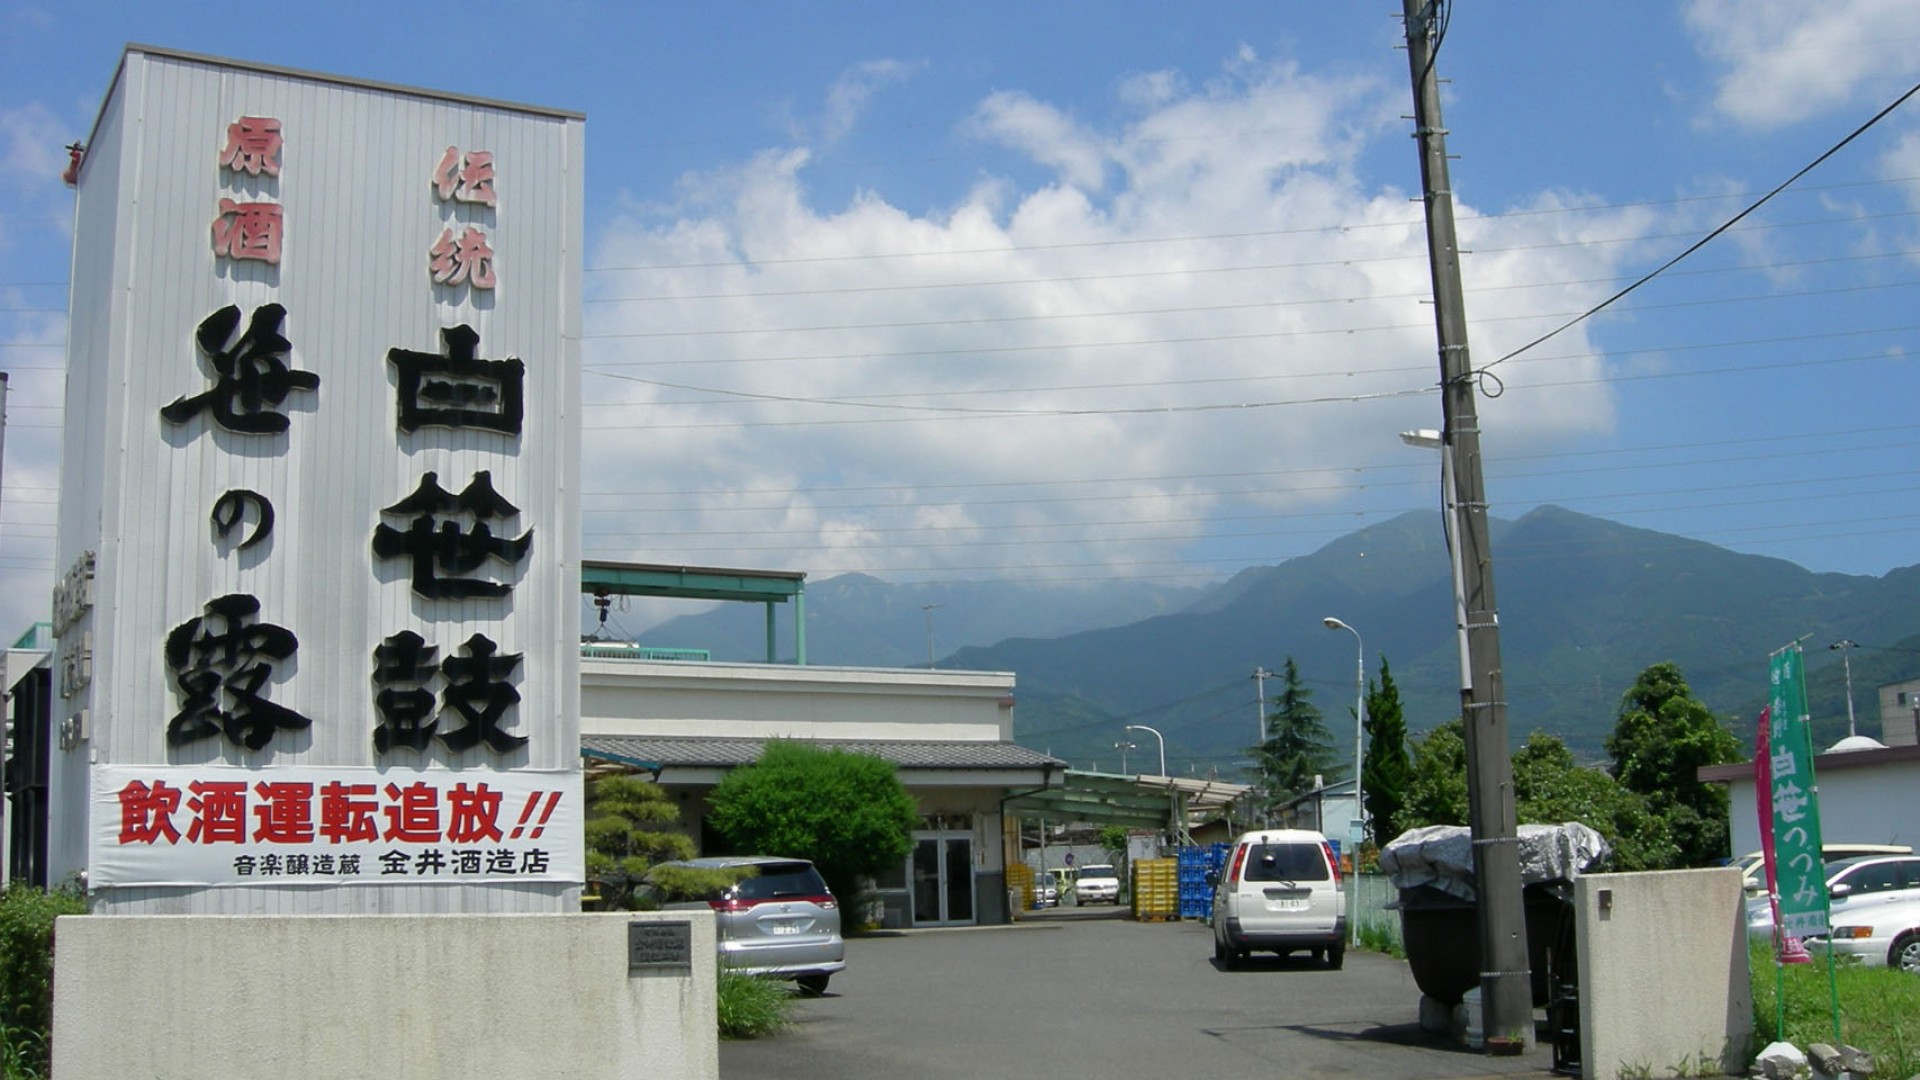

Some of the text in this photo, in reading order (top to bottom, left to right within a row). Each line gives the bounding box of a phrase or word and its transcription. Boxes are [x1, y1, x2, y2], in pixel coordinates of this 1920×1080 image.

[211, 115, 284, 266] 原酒
[430, 145, 497, 290] 伝統
[378, 849, 550, 875] 金井酒造店
